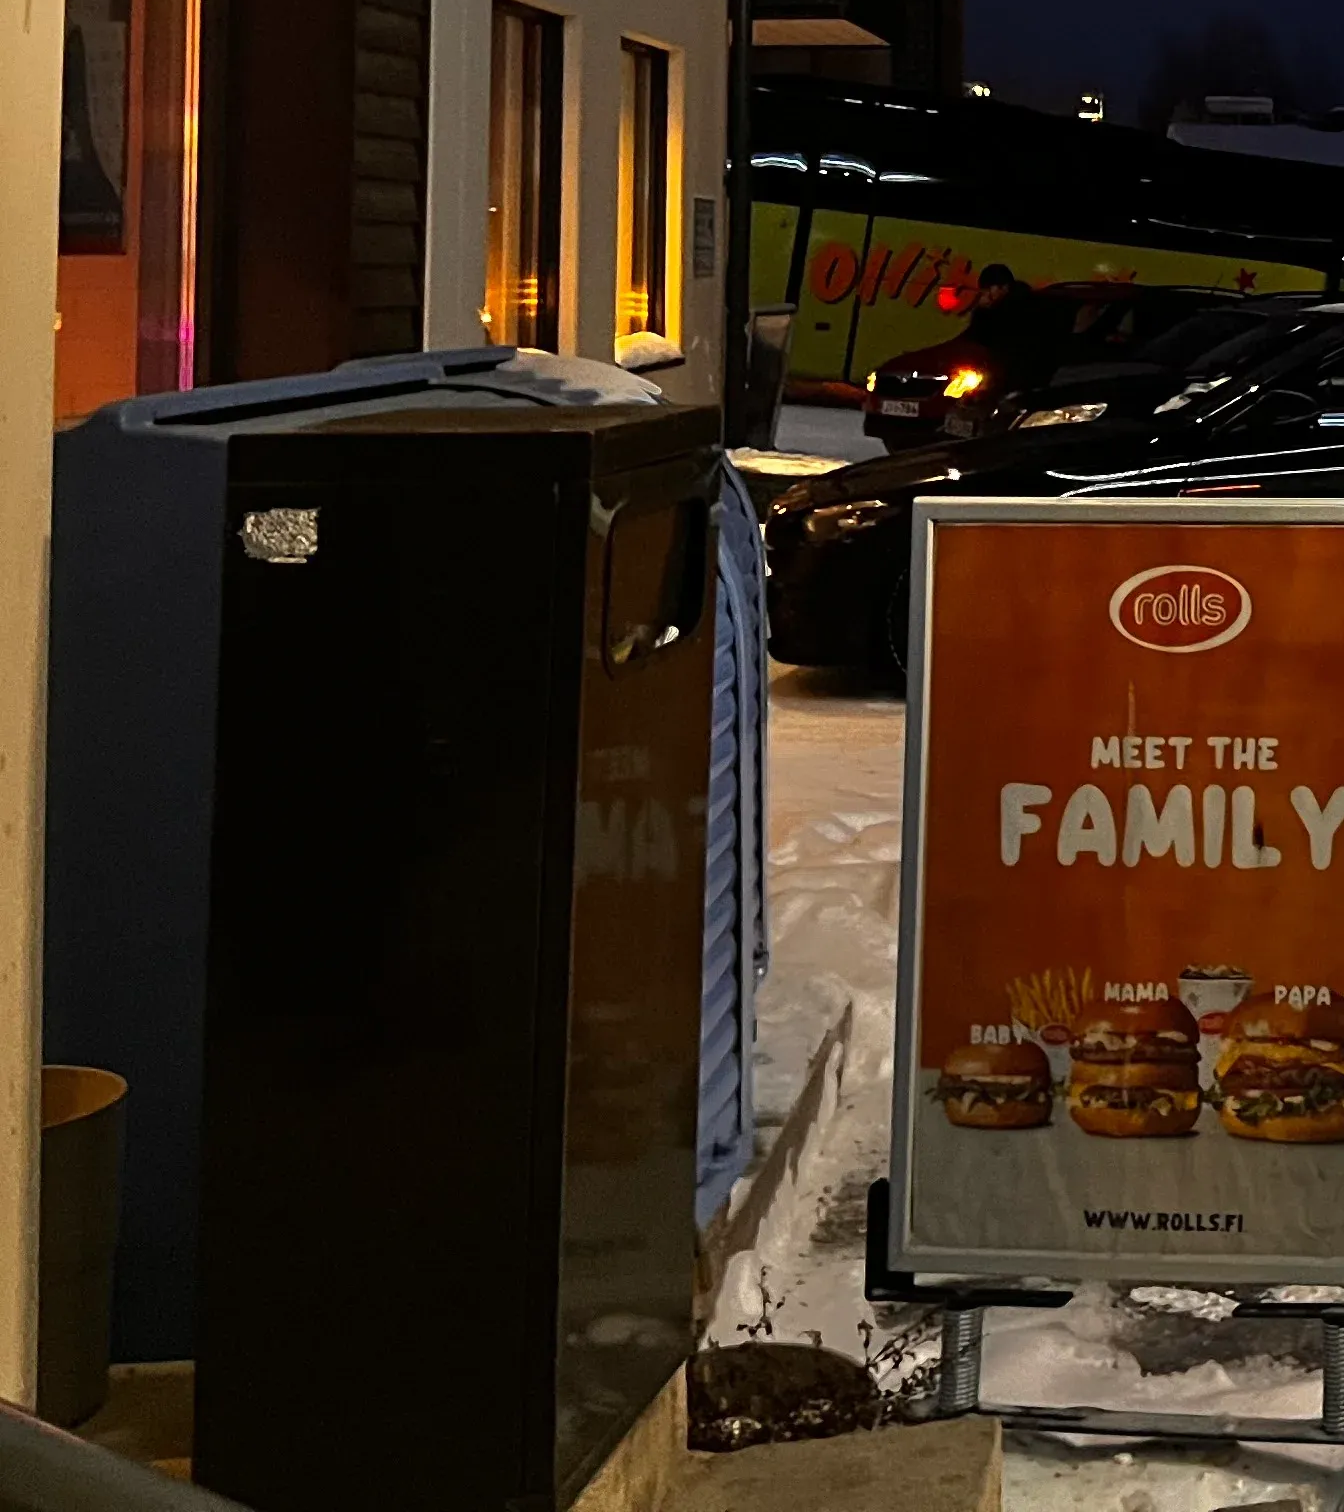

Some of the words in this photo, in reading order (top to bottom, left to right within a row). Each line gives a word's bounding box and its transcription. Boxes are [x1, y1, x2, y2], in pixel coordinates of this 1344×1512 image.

[1134, 583, 1227, 626] rolls
[1091, 736, 1193, 770] MEET
[1207, 737, 1279, 771] THE
[1103, 981, 1169, 1002] MAMA
[1274, 984, 1332, 1006] PAPA
[970, 1024, 1027, 1045] BABY
[1083, 1209, 1244, 1233] WWW.ROLLS.FI
